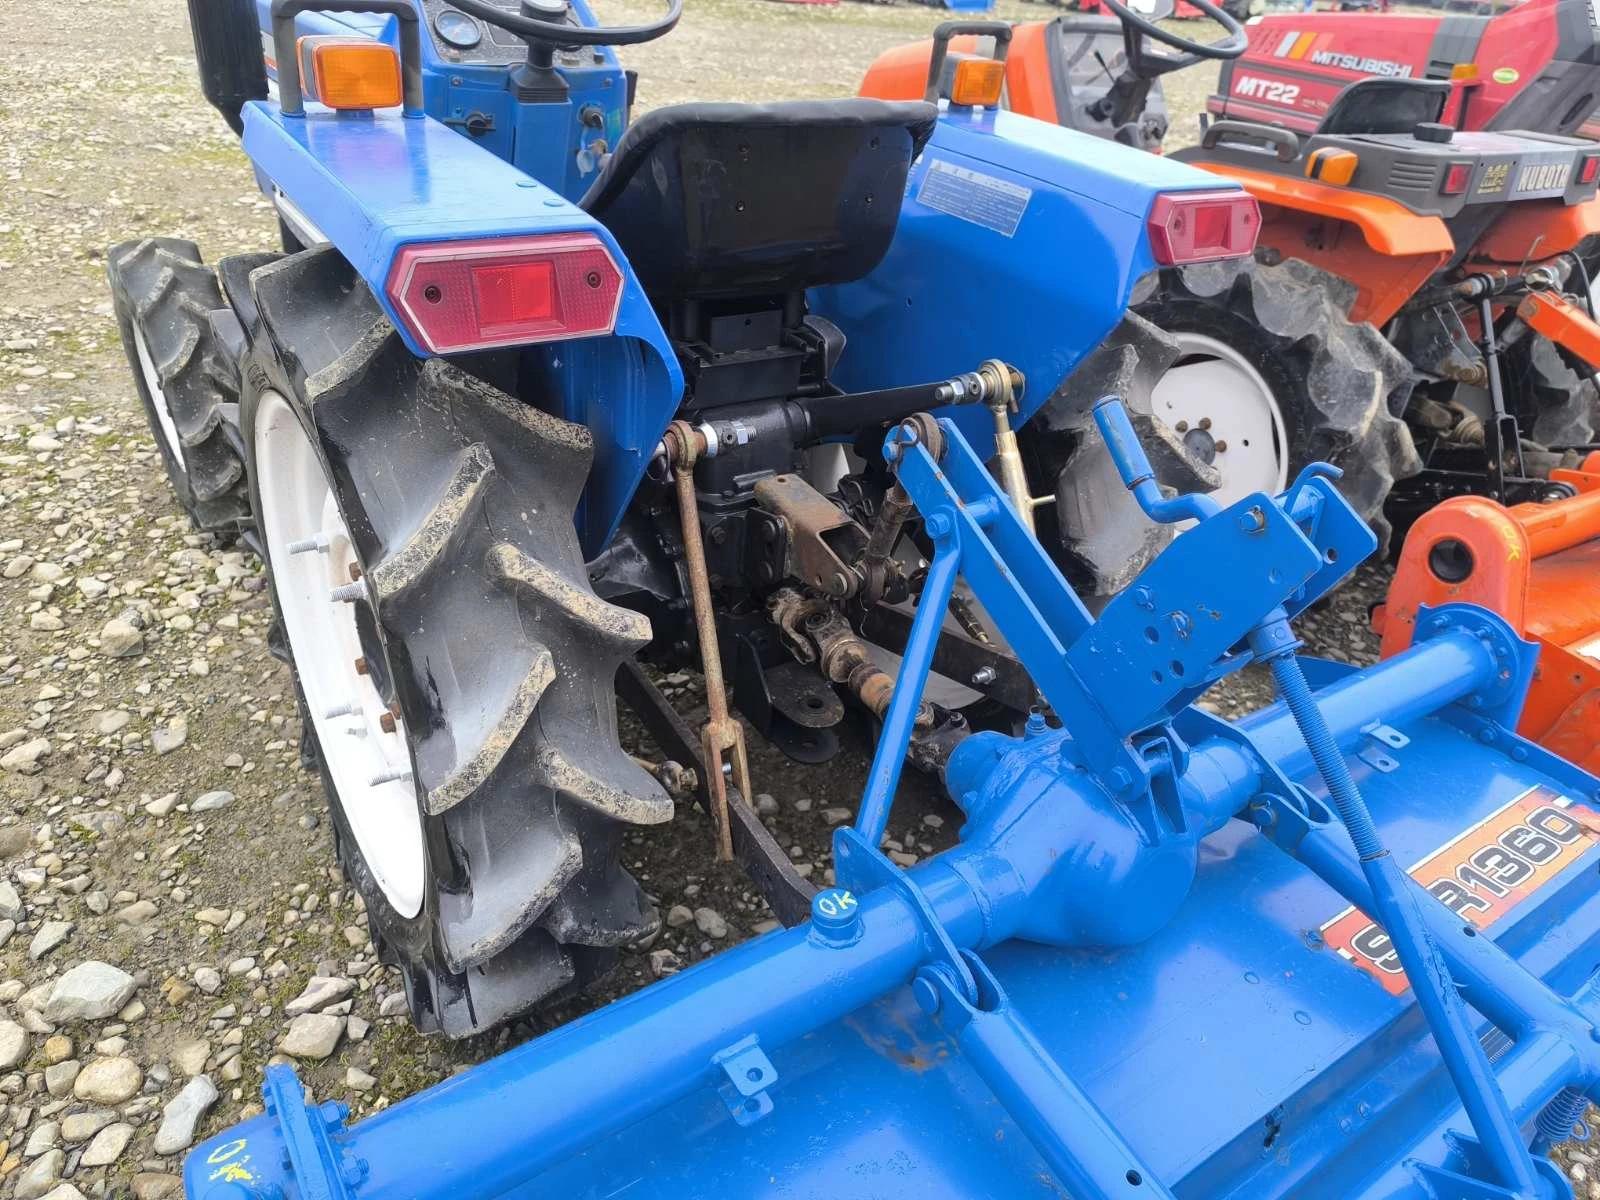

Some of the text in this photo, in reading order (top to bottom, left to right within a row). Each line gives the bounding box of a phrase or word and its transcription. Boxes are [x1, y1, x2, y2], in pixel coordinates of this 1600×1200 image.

[1311, 51, 1412, 78] MITSUBISHI
[1235, 77, 1300, 105] MT22
[1516, 164, 1570, 192] KUBOTA
[819, 890, 858, 915] OK
